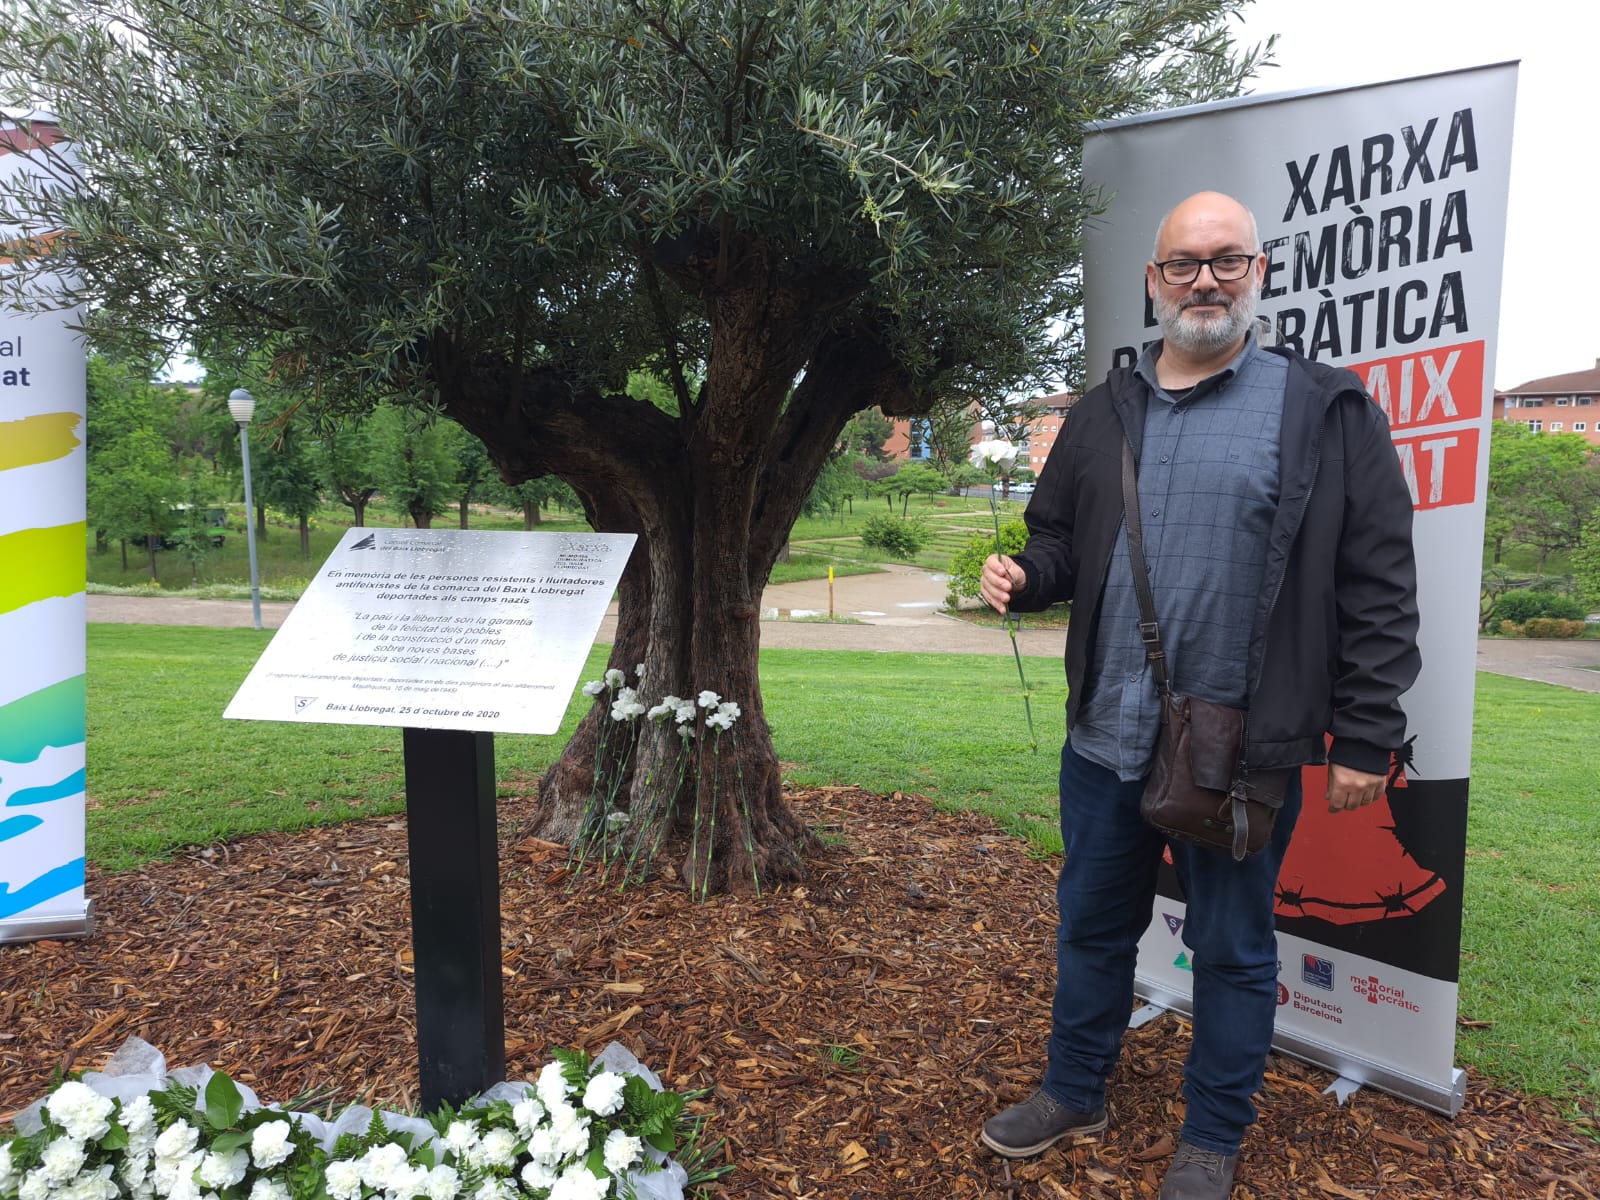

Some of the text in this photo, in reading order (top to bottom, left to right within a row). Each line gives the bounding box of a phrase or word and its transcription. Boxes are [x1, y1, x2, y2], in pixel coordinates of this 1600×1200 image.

[1282, 107, 1479, 223] XARXA
[1260, 190, 1473, 301] EMÒRIA
[0, 335, 21, 357] al
[3, 367, 31, 387] at
[1366, 350, 1462, 426] AIX
[1394, 436, 1459, 505] AT
[327, 570, 341, 578] En
[344, 570, 391, 579] memòria
[394, 572, 407, 580] de
[410, 572, 425, 580] les
[427, 574, 479, 582] persones
[482, 575, 536, 584] resistents
[546, 576, 605, 586] lluitadores
[335, 580, 401, 590] antifeixistes
[403, 582, 418, 590] de
[420, 583, 430, 591] la
[503, 585, 528, 593] Baix
[530, 587, 585, 597] Llobregat
[376, 592, 438, 601] deportades
[441, 593, 457, 602] als
[460, 595, 497, 604] camps
[400, 613, 411, 621] la
[412, 614, 453, 623] llibertat
[476, 616, 486, 625] la
[487, 618, 533, 626] garantia
[371, 623, 502, 635] de la felicitat dels pobles
[362, 633, 377, 641] de
[378, 633, 389, 641] la
[391, 635, 453, 643] construcció
[373, 644, 476, 655] sobre noves bases
[332, 653, 347, 661] de
[430, 657, 479, 667] nacional
[297, 699, 308, 708] S
[326, 703, 347, 711] Baix
[399, 706, 413, 714] 25
[462, 709, 474, 717] de
[476, 710, 501, 718] 2020
[1169, 918, 1177, 928] S
[1293, 990, 1343, 1015] Diputació
[1293, 1000, 1343, 1024] Barcelona
